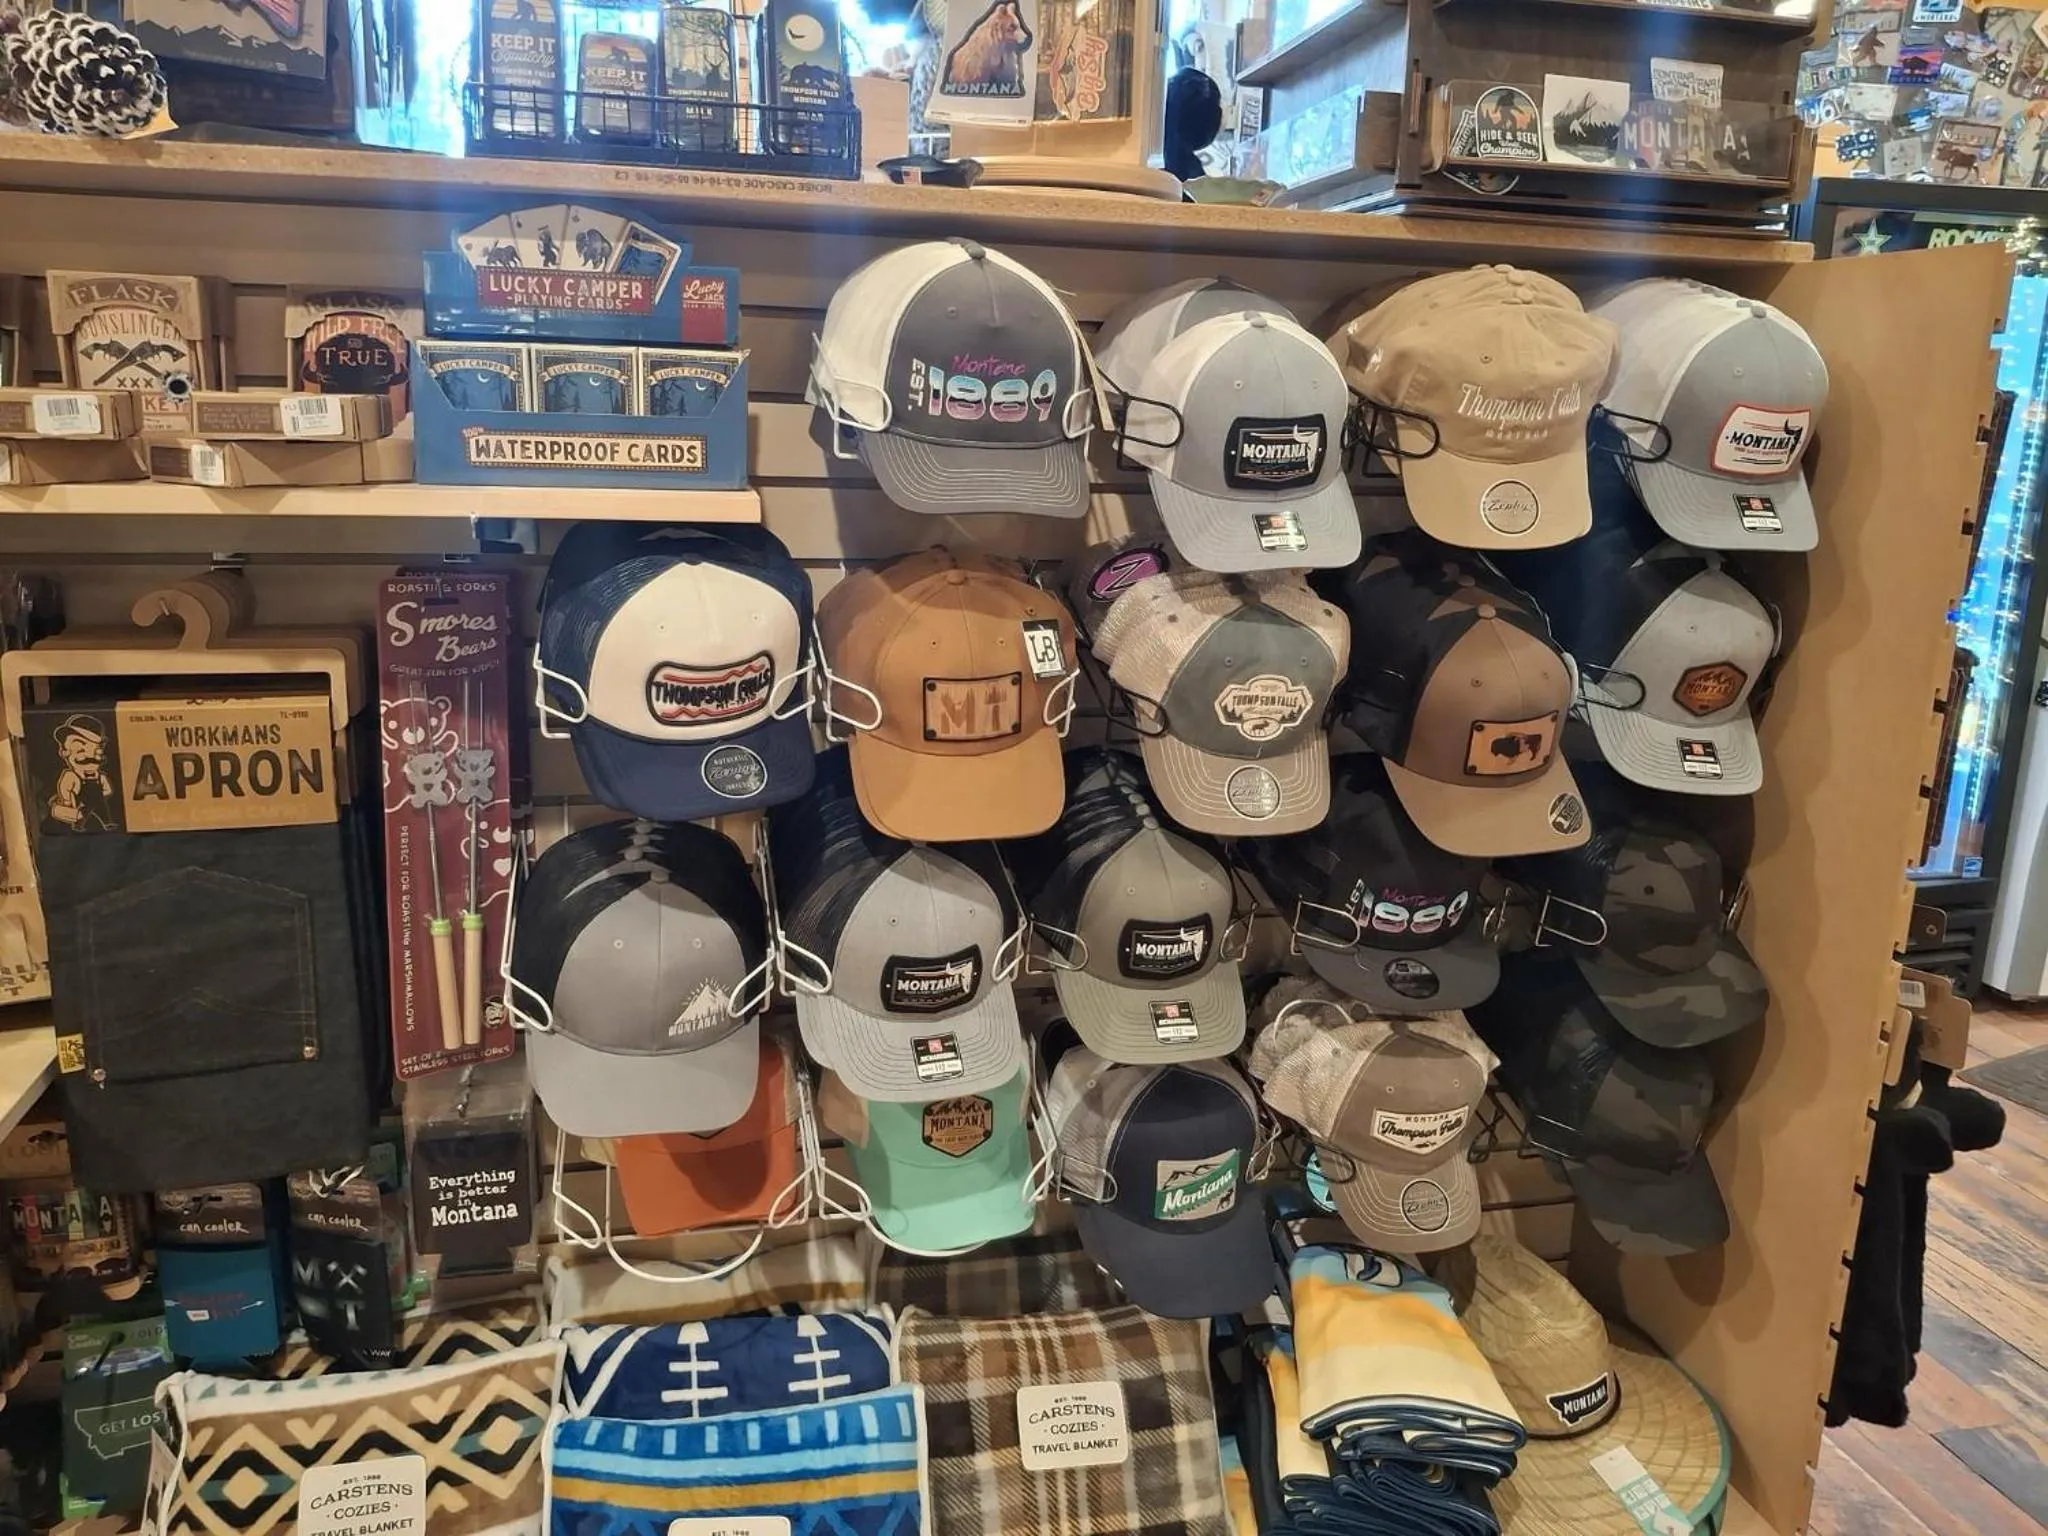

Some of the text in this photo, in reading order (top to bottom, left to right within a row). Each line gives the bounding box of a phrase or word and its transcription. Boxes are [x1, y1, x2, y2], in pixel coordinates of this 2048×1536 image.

[491, 33, 556, 52] KEEP IT
[586, 66, 647, 81] KEEP IT
[944, 82, 1021, 95] MONTANA
[1480, 129, 1502, 142] HIDE
[1516, 131, 1538, 146] SEEK
[1480, 142, 1538, 157] Champion
[743, 180, 796, 191] CASCADE
[69, 283, 176, 310] FLASK
[489, 274, 643, 299] LUCKY CAMPER
[685, 280, 725, 299] Lucky
[80, 312, 182, 340] GUNSLINGER
[304, 317, 351, 355] WILD
[319, 347, 389, 367] TRUE
[952, 353, 1027, 376] Montana
[908, 358, 1057, 423] EST. 1889
[1458, 381, 1581, 430] Thompson Falls
[475, 437, 699, 464] WATERPROOF CARDS
[1729, 430, 1791, 450] MONTANA
[1242, 443, 1306, 459] MONTANA
[386, 601, 498, 647] S'mores
[435, 634, 497, 662] Bears
[652, 680, 737, 707] THOMPSON
[1233, 694, 1299, 708] THOMPSON FALLS
[159, 714, 184, 722] BLACK
[165, 723, 282, 748] WORKMANS
[133, 748, 325, 801] APRON
[1358, 890, 1469, 934] 1889
[400, 825, 415, 1032] PERFECT FOR ROASTING MARSHMALLOWS
[1135, 941, 1193, 956] MONTANA
[897, 975, 960, 991] MONTANA
[668, 1015, 717, 1037] MONTANA
[930, 1113, 986, 1135] MONTANA
[1381, 1117, 1463, 1141] Thompson Falls
[428, 1169, 516, 1190] Everything
[1163, 1168, 1233, 1212] Montana
[438, 1185, 508, 1201] is better
[457, 1198, 472, 1207] in
[13, 1195, 113, 1231] MONTAA
[307, 1212, 369, 1232] can cooler
[431, 1202, 519, 1227] Montana
[179, 1218, 250, 1234] can cooler
[1563, 1385, 1606, 1415] MONTANA
[99, 1410, 169, 1435] GET LOST
[1029, 1404, 1116, 1425] CARSTENS
[1050, 1421, 1099, 1435] COZIES
[1032, 1438, 1119, 1456] TRAVEL BLANKET
[310, 1483, 413, 1510] CARSTENS
[334, 1501, 391, 1520] COZIES
[360, 1518, 415, 1535] BLANKET
